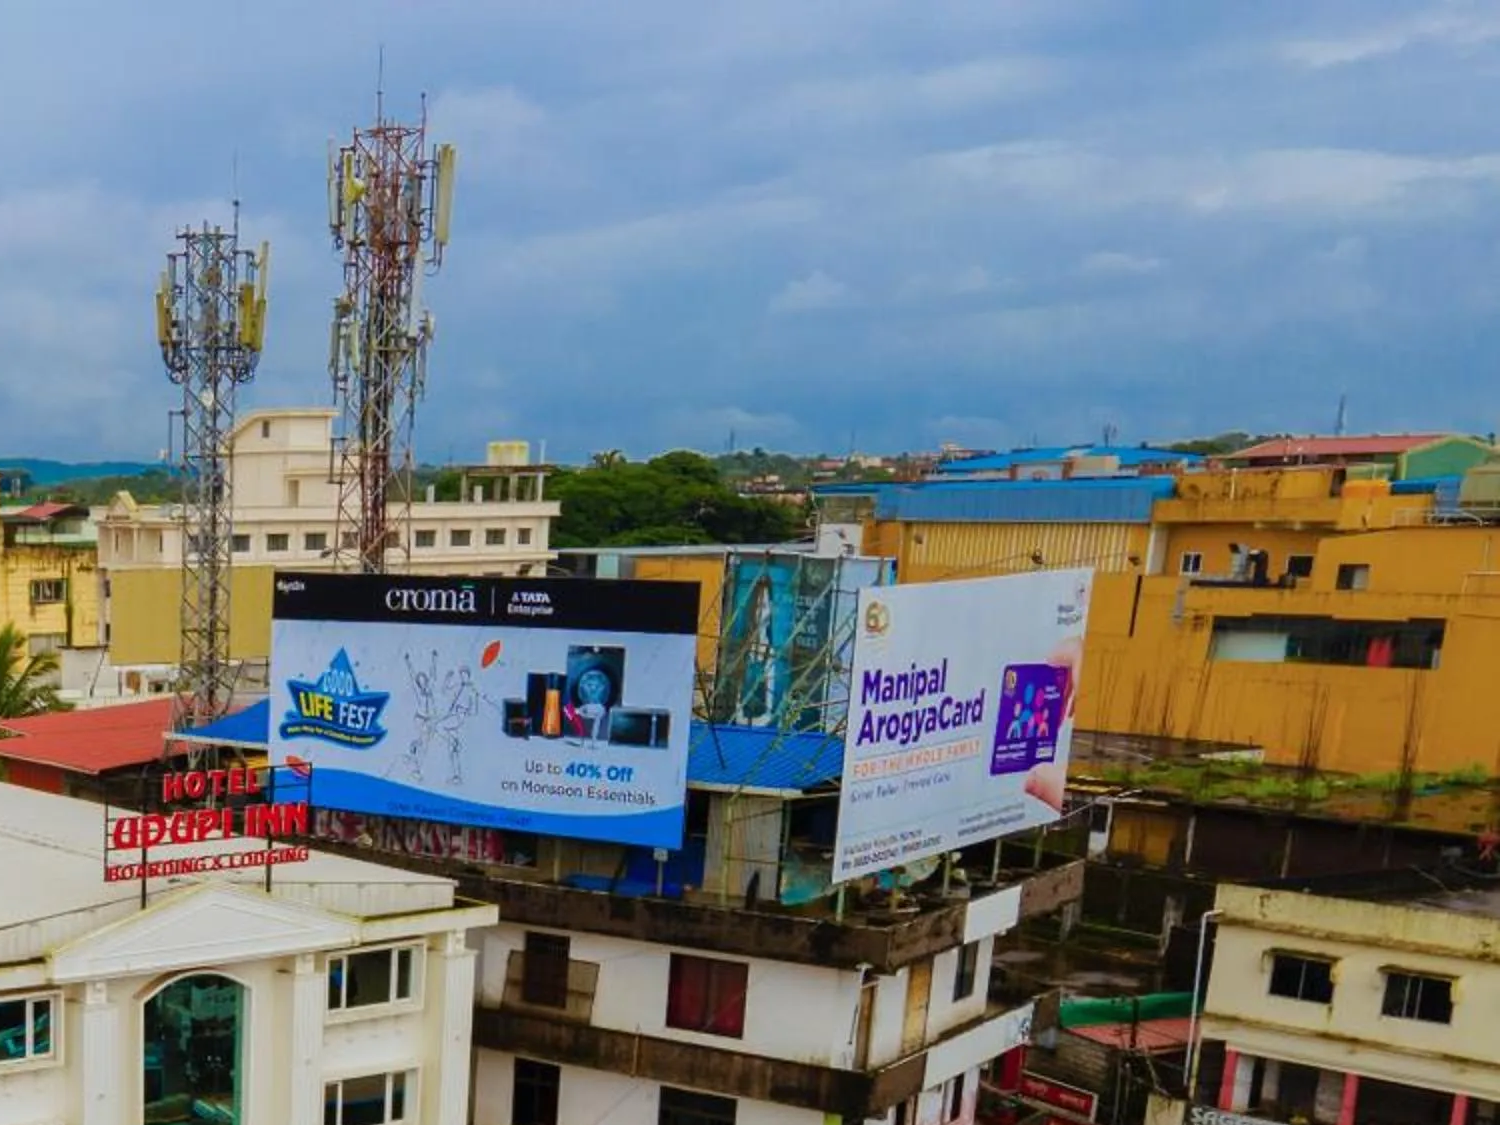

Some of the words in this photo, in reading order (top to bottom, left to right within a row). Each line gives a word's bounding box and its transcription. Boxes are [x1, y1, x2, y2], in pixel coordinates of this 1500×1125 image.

[520, 592, 551, 603] TATA
[861, 657, 948, 706] Manipal
[299, 690, 333, 721] LIFE
[339, 702, 377, 732] FEST
[855, 687, 986, 747] ArogyaCard
[162, 767, 261, 802] HOTEL
[525, 759, 543, 776] Up
[547, 761, 562, 775] to
[565, 762, 602, 780] 40%
[607, 766, 634, 783] Off
[501, 779, 518, 793] on
[522, 780, 583, 799] Monsoon
[587, 785, 656, 806] Essentials
[112, 807, 234, 850] UDUPI
[243, 801, 309, 838] INN
[106, 858, 207, 882] BOARDING
[229, 845, 309, 868] LODGING
